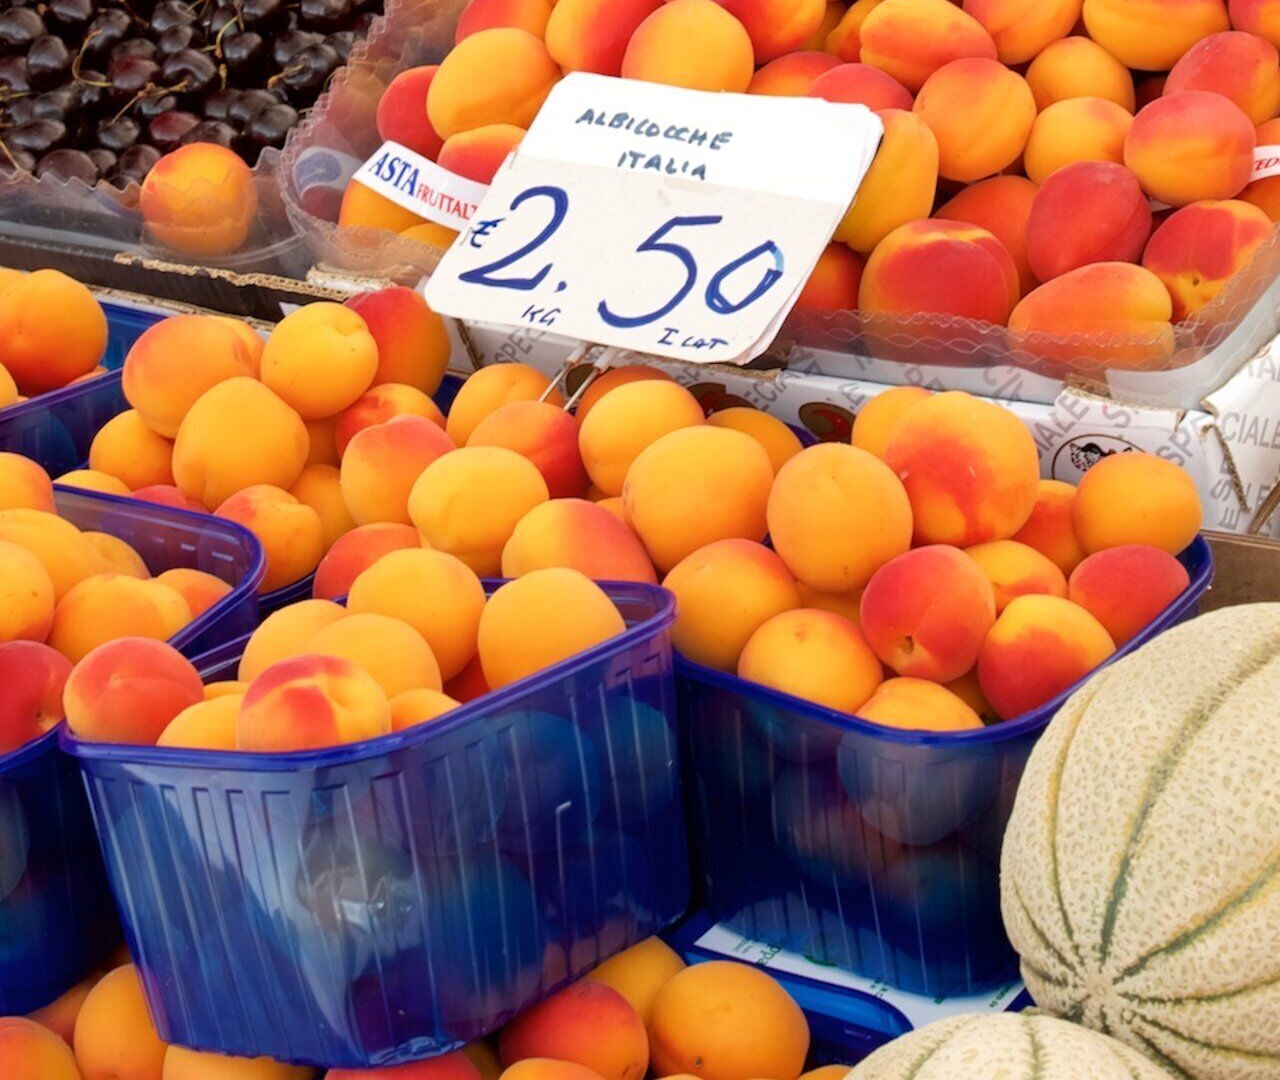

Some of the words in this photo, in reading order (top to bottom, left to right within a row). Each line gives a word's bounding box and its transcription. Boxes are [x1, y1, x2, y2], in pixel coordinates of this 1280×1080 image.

[575, 108, 733, 151] ALBICOCCHE
[368, 151, 420, 198] ASTA
[616, 151, 707, 181] ITALIA
[468, 218, 505, 249] €
[520, 305, 562, 327] KG
